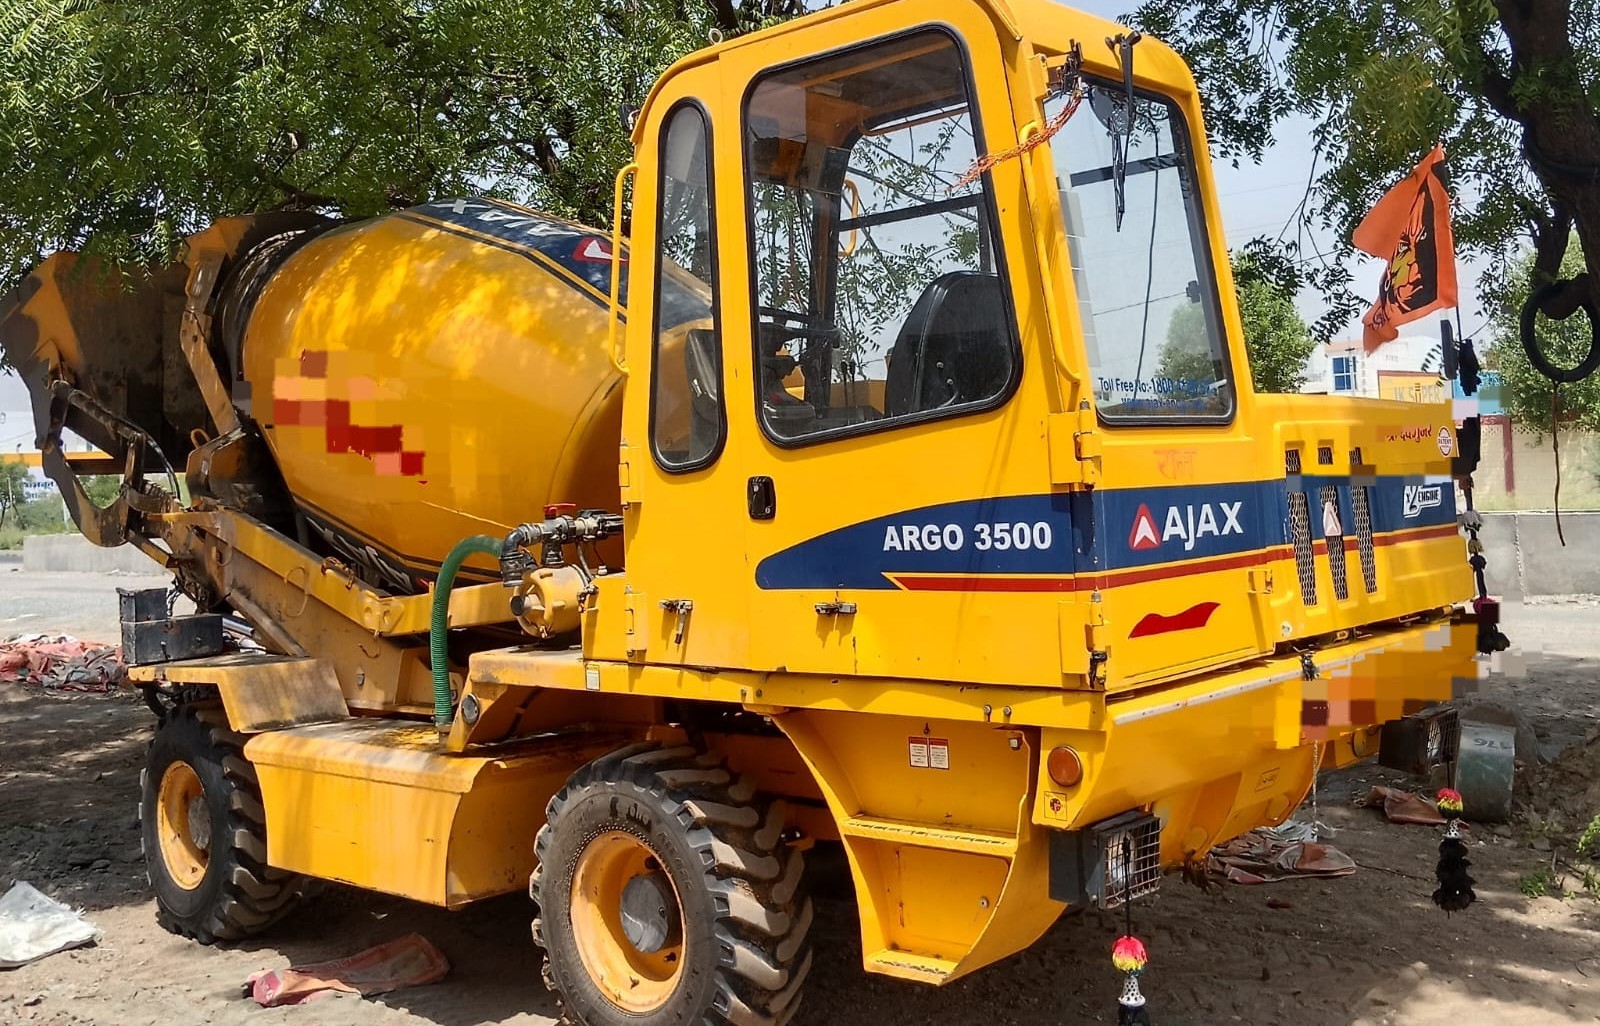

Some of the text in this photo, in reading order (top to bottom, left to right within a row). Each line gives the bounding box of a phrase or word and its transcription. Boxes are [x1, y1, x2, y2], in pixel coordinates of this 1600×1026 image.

[1098, 377, 1113, 392] Toll
[1115, 378, 1134, 392] Free
[1418, 490, 1438, 502] ENGINE
[883, 521, 1051, 551] ARGO 3500
[1162, 501, 1244, 550] AJAX
